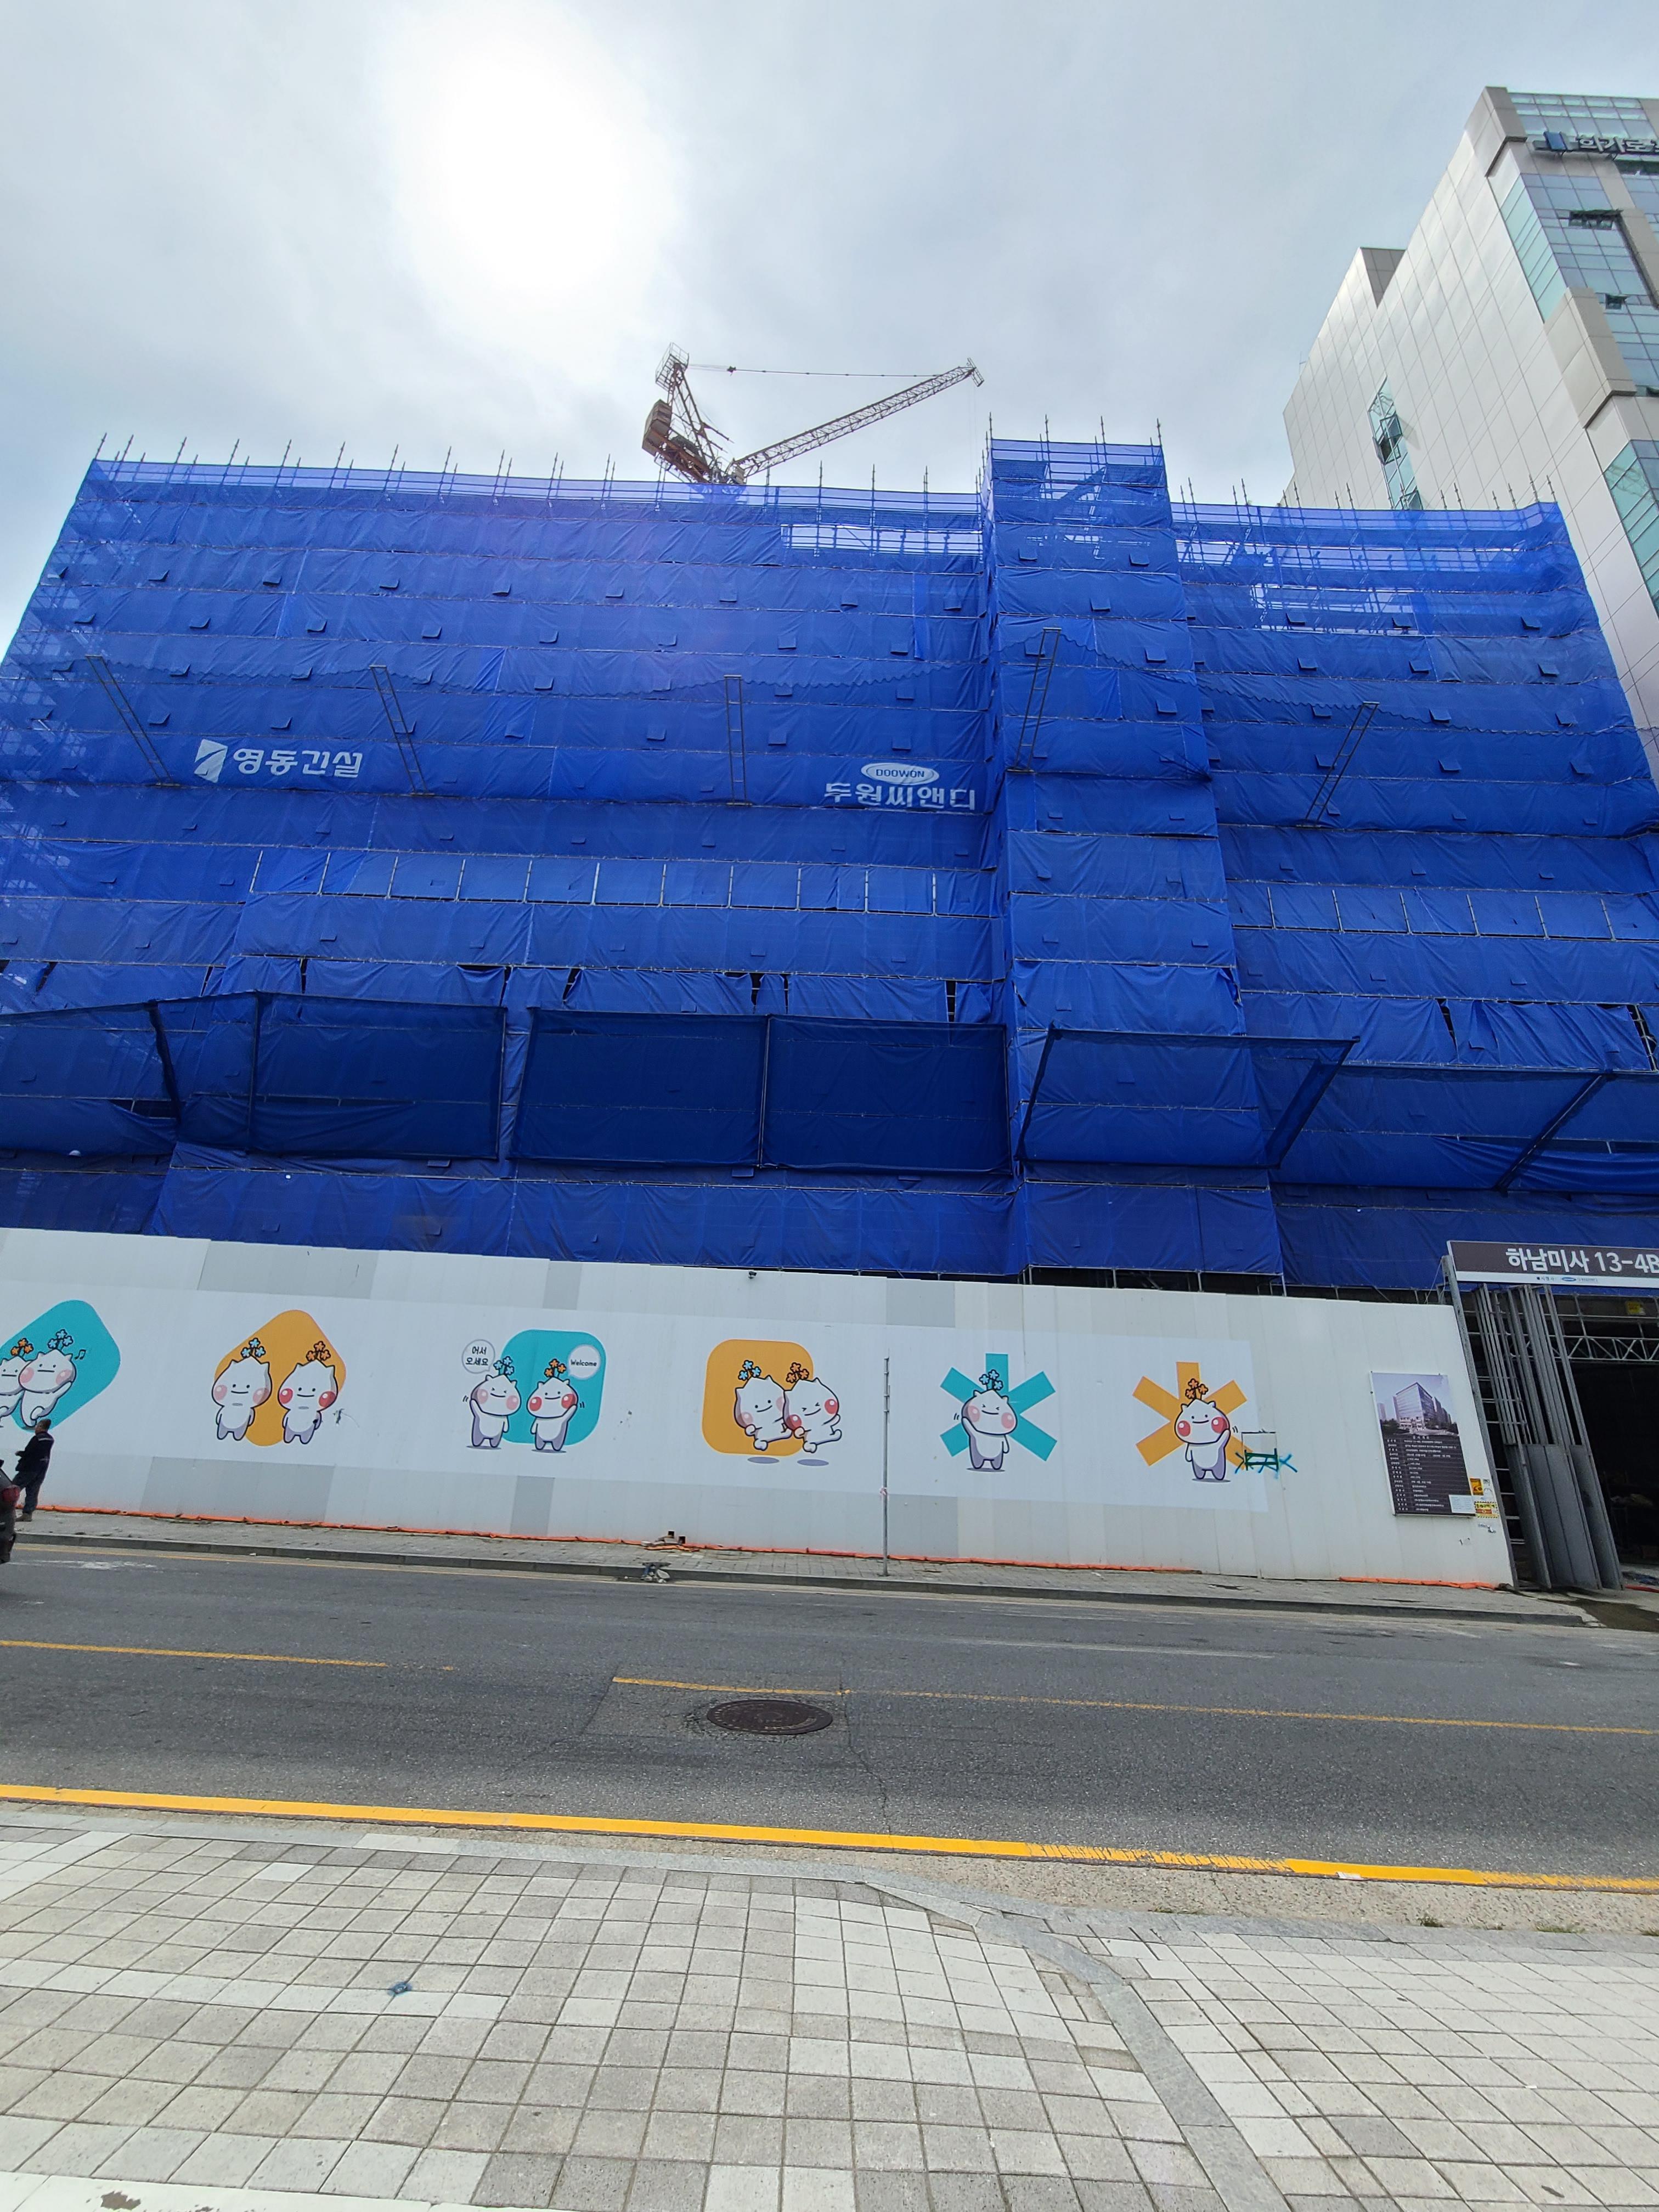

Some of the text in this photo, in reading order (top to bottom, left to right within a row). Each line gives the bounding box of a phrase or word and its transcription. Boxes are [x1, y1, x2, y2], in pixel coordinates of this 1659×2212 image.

[876, 769, 925, 778] DOOWON
[823, 782, 975, 811] 두원씨앤디
[1505, 1248, 1590, 1273] 하남미사
[471, 1346, 487, 1355] 어서
[465, 1357, 489, 1367] 오세요
[570, 1359, 597, 1367] Welcome
